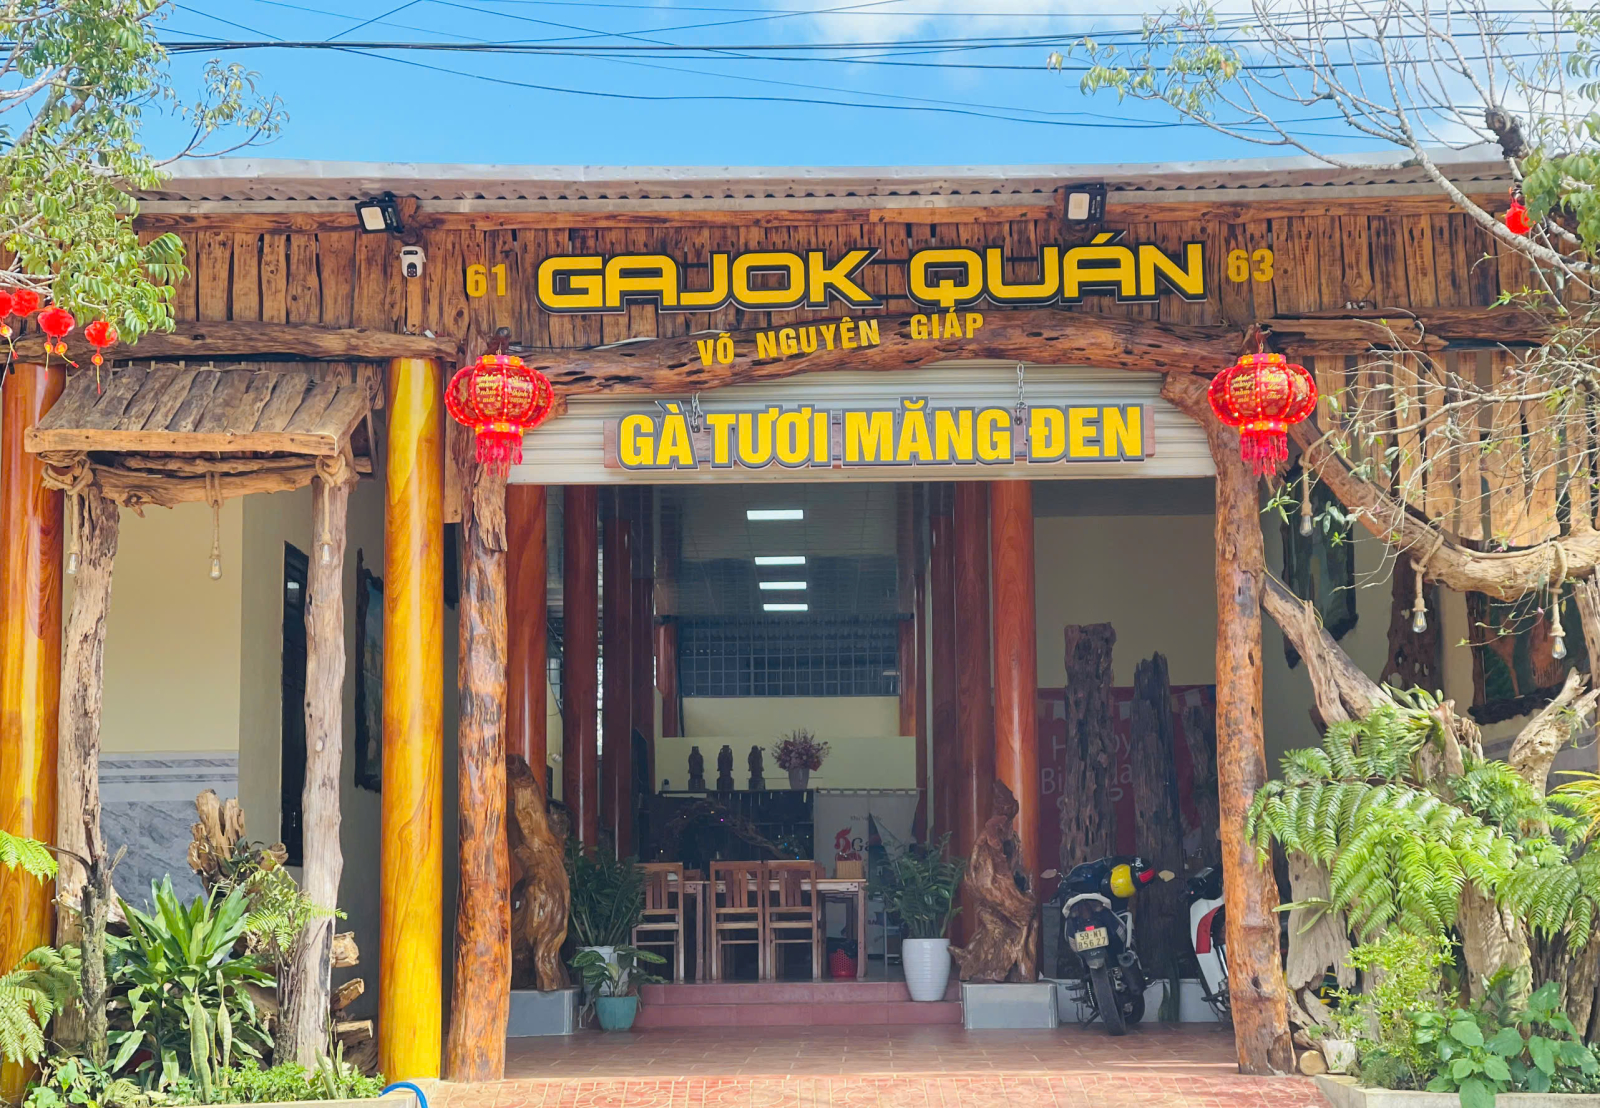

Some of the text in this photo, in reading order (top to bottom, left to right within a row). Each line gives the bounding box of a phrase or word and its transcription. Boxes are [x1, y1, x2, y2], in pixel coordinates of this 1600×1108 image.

[466, 263, 507, 298] 61
[537, 232, 1205, 309] GAJOK QUÁN
[1227, 248, 1275, 284] 63
[696, 306, 984, 367] VÕ NGUYÊN GIÁP
[620, 399, 1143, 466] GÀ TƯƠI MĂNG ĐEN
